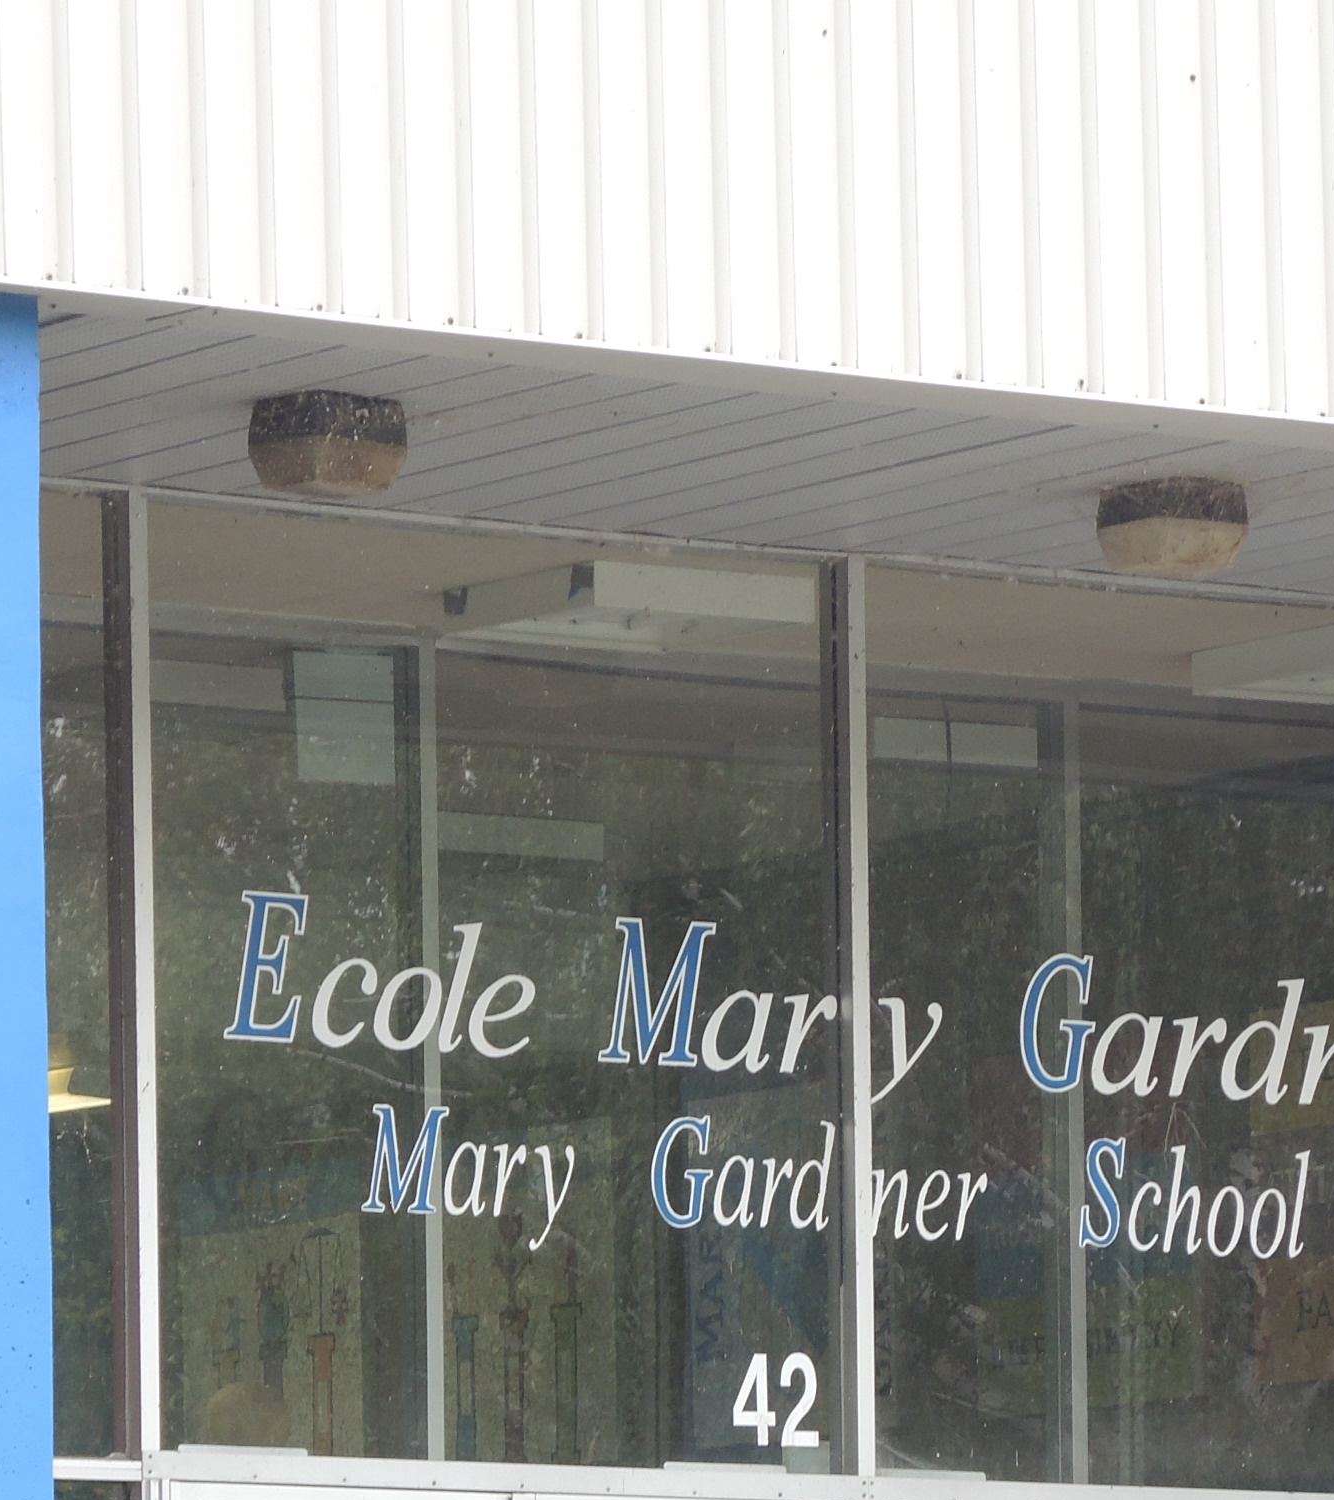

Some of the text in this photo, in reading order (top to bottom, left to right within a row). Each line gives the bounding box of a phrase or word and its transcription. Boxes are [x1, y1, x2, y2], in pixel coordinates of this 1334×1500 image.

[223, 890, 536, 1059] Ecole
[598, 917, 943, 1105] Mary
[361, 1103, 1312, 1260] Mary Gardner School
[732, 1352, 819, 1447] 42
